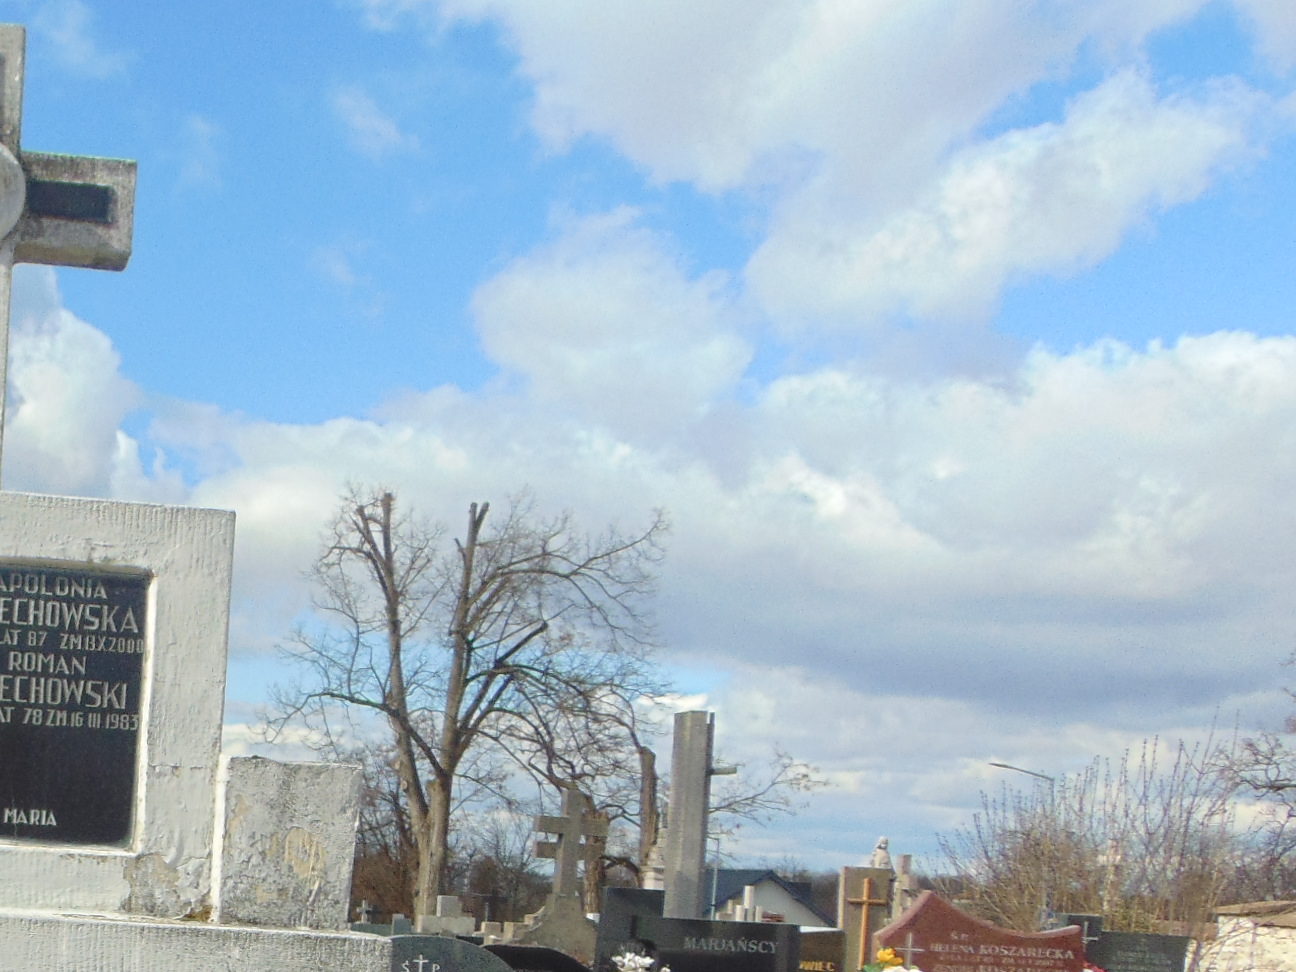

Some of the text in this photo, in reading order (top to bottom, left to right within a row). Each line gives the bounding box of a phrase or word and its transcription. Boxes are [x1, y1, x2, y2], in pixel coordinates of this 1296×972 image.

[28, 631, 47, 646] 87
[8, 651, 86, 675] ROMAN
[22, 707, 42, 725] 78
[4, 807, 57, 826] MARIA
